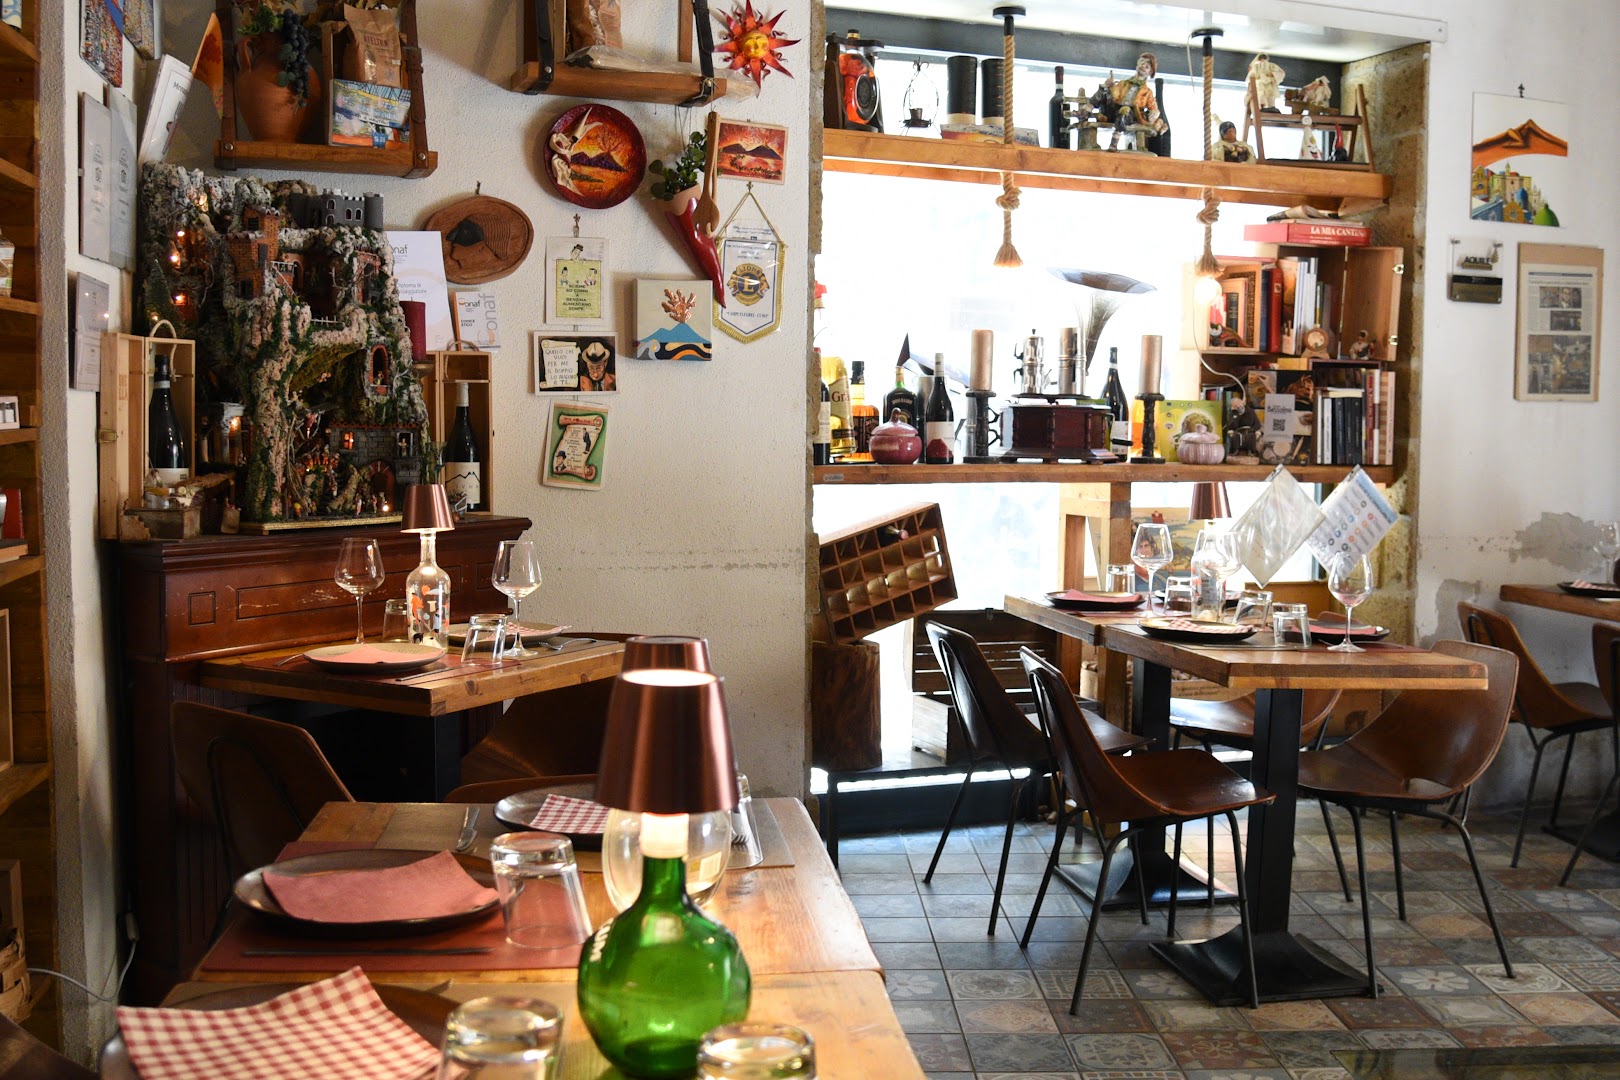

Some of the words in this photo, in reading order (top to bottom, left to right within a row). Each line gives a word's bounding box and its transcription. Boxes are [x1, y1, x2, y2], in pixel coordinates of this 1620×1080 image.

[1310, 226, 1321, 235] LA
[1321, 226, 1336, 236] MIA
[738, 266, 761, 276] LIONS
[743, 276, 754, 293] L
